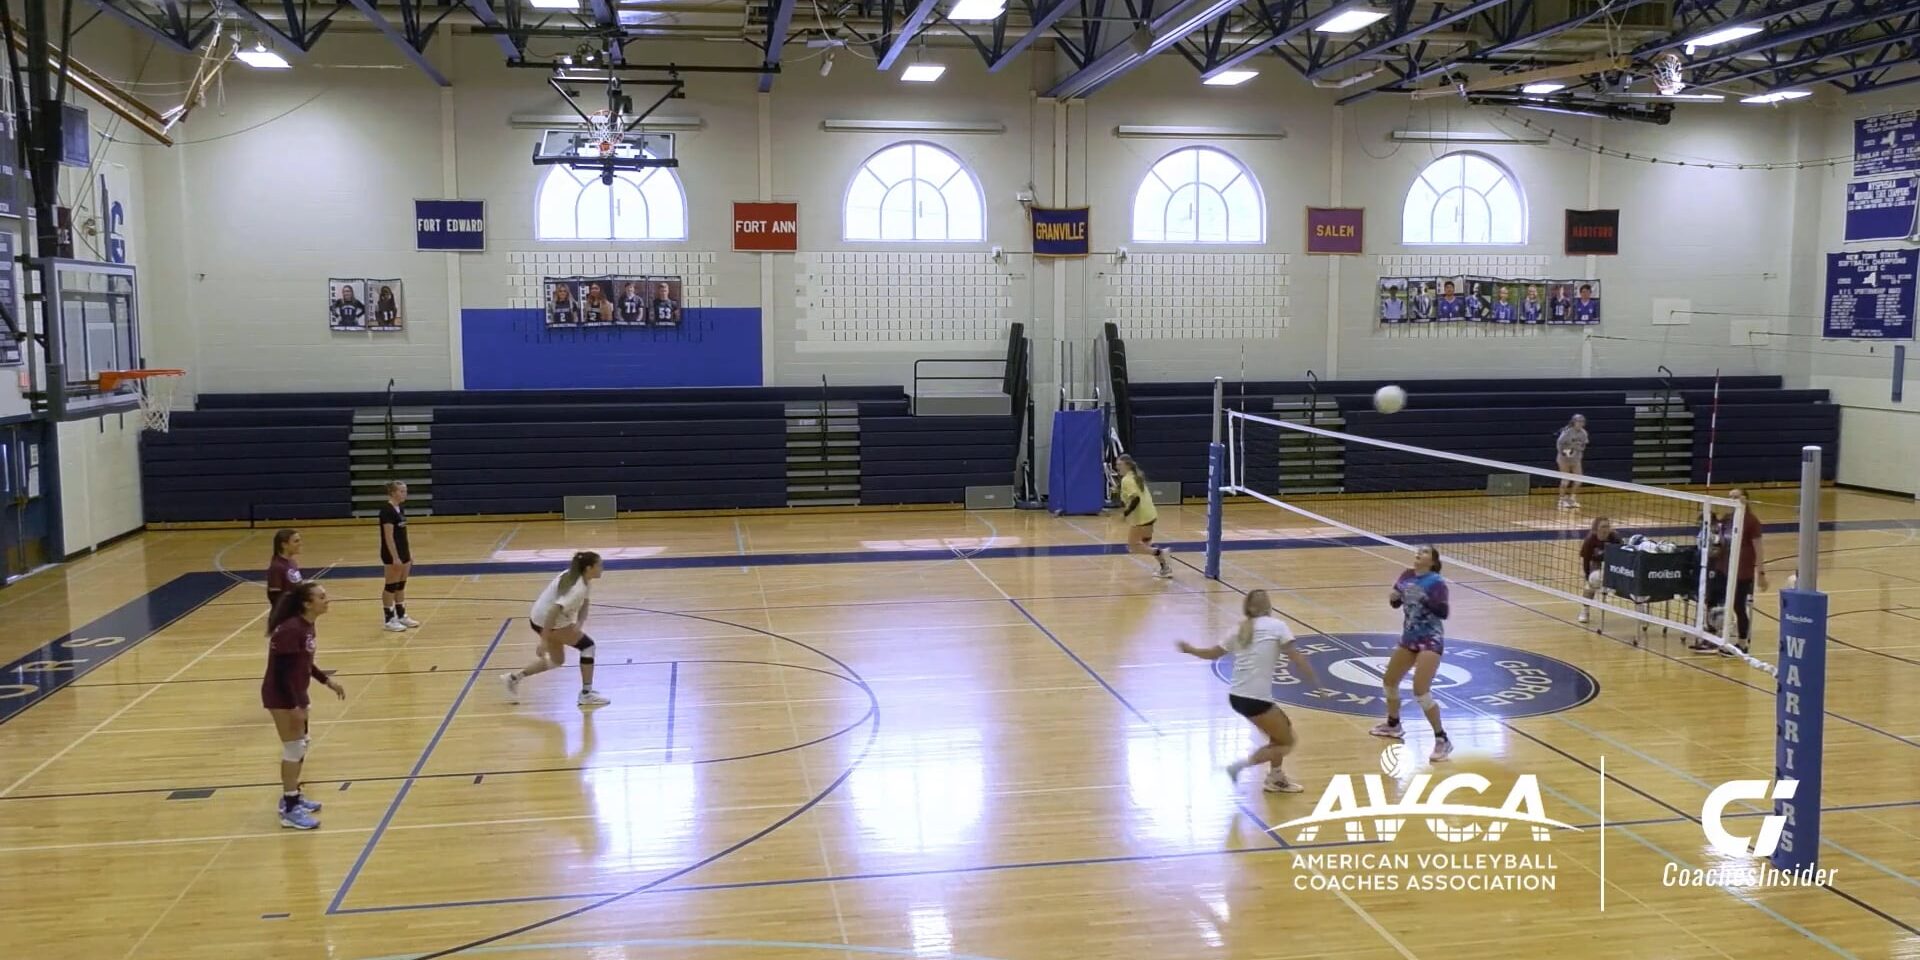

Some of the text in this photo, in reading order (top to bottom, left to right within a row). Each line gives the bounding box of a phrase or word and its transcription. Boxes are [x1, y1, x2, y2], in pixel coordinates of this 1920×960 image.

[418, 218, 483, 232] FORT EDWARD
[735, 220, 796, 233] FORT ANN
[1036, 222, 1085, 240] GRANVILLE
[1316, 224, 1355, 237] SALEM
[1469, 660, 1553, 706] GEORGE
[1780, 634, 1806, 853] WARRIRS
